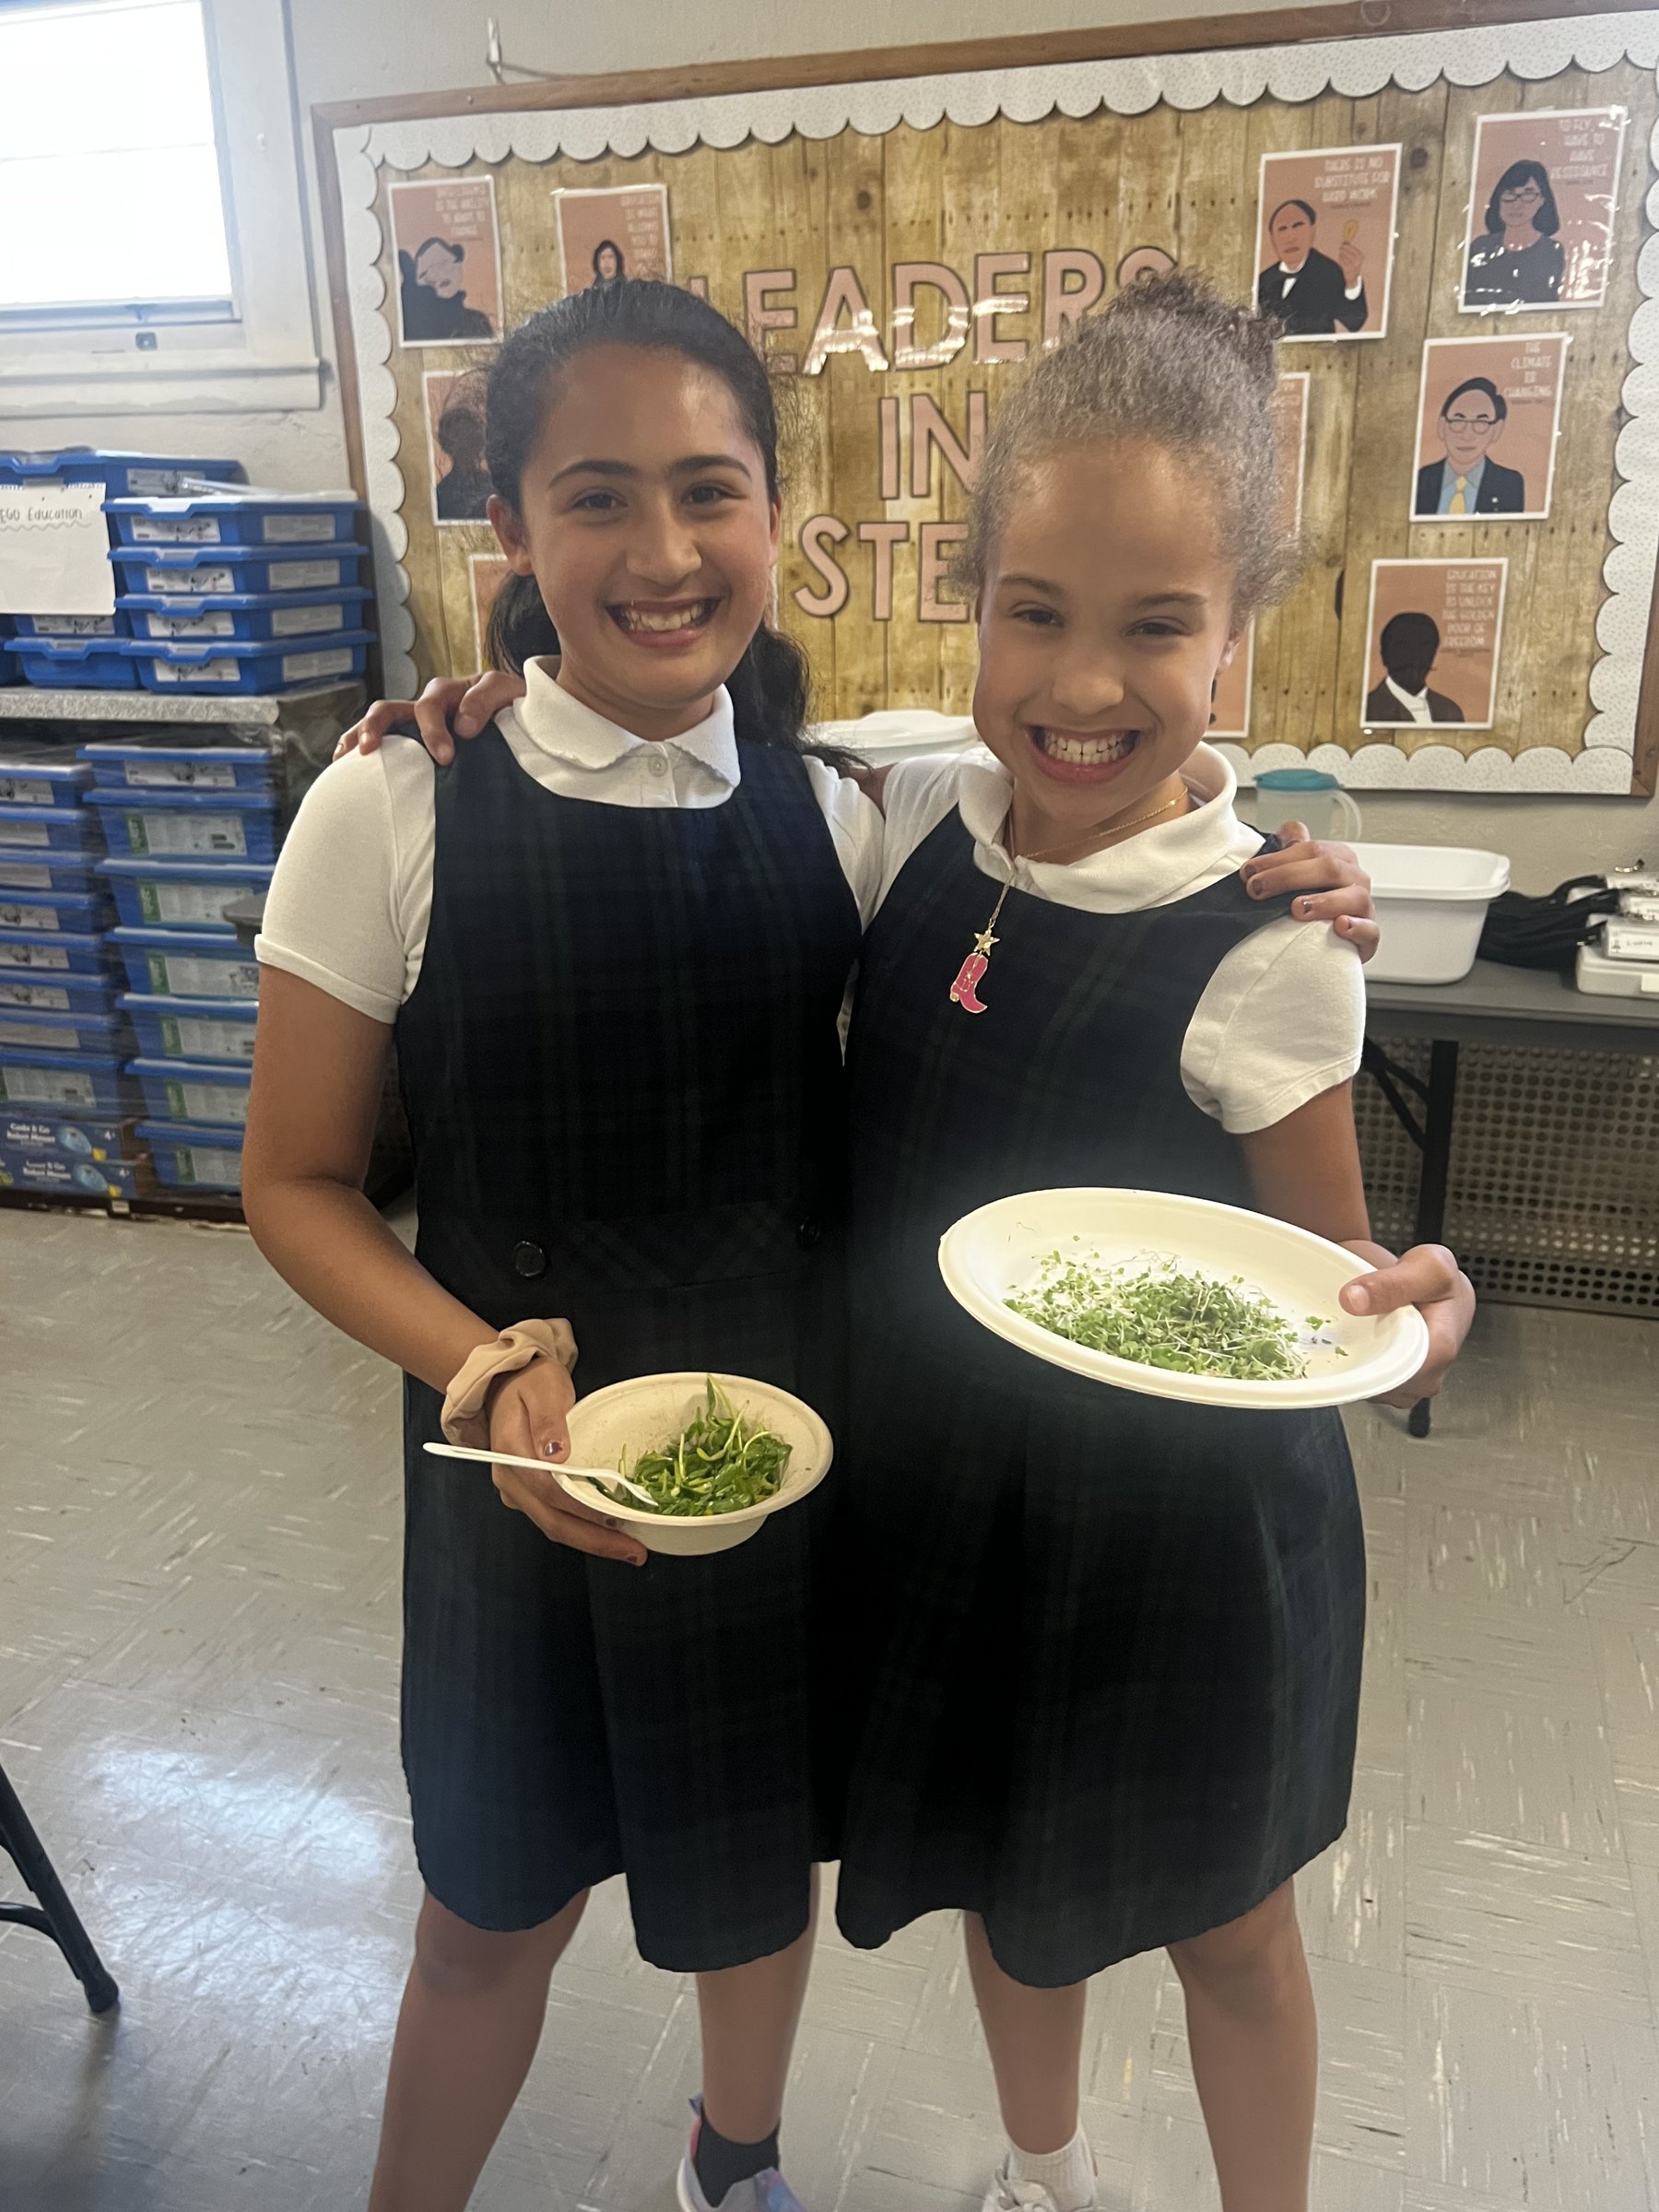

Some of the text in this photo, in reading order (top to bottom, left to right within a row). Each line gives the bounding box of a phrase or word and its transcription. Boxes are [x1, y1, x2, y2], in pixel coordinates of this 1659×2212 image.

[689, 246, 1177, 375] EADER
[1511, 355, 1552, 369] CLIMATE
[878, 390, 989, 500] IN
[0, 506, 83, 524] EGO Education
[793, 514, 971, 622] STE
